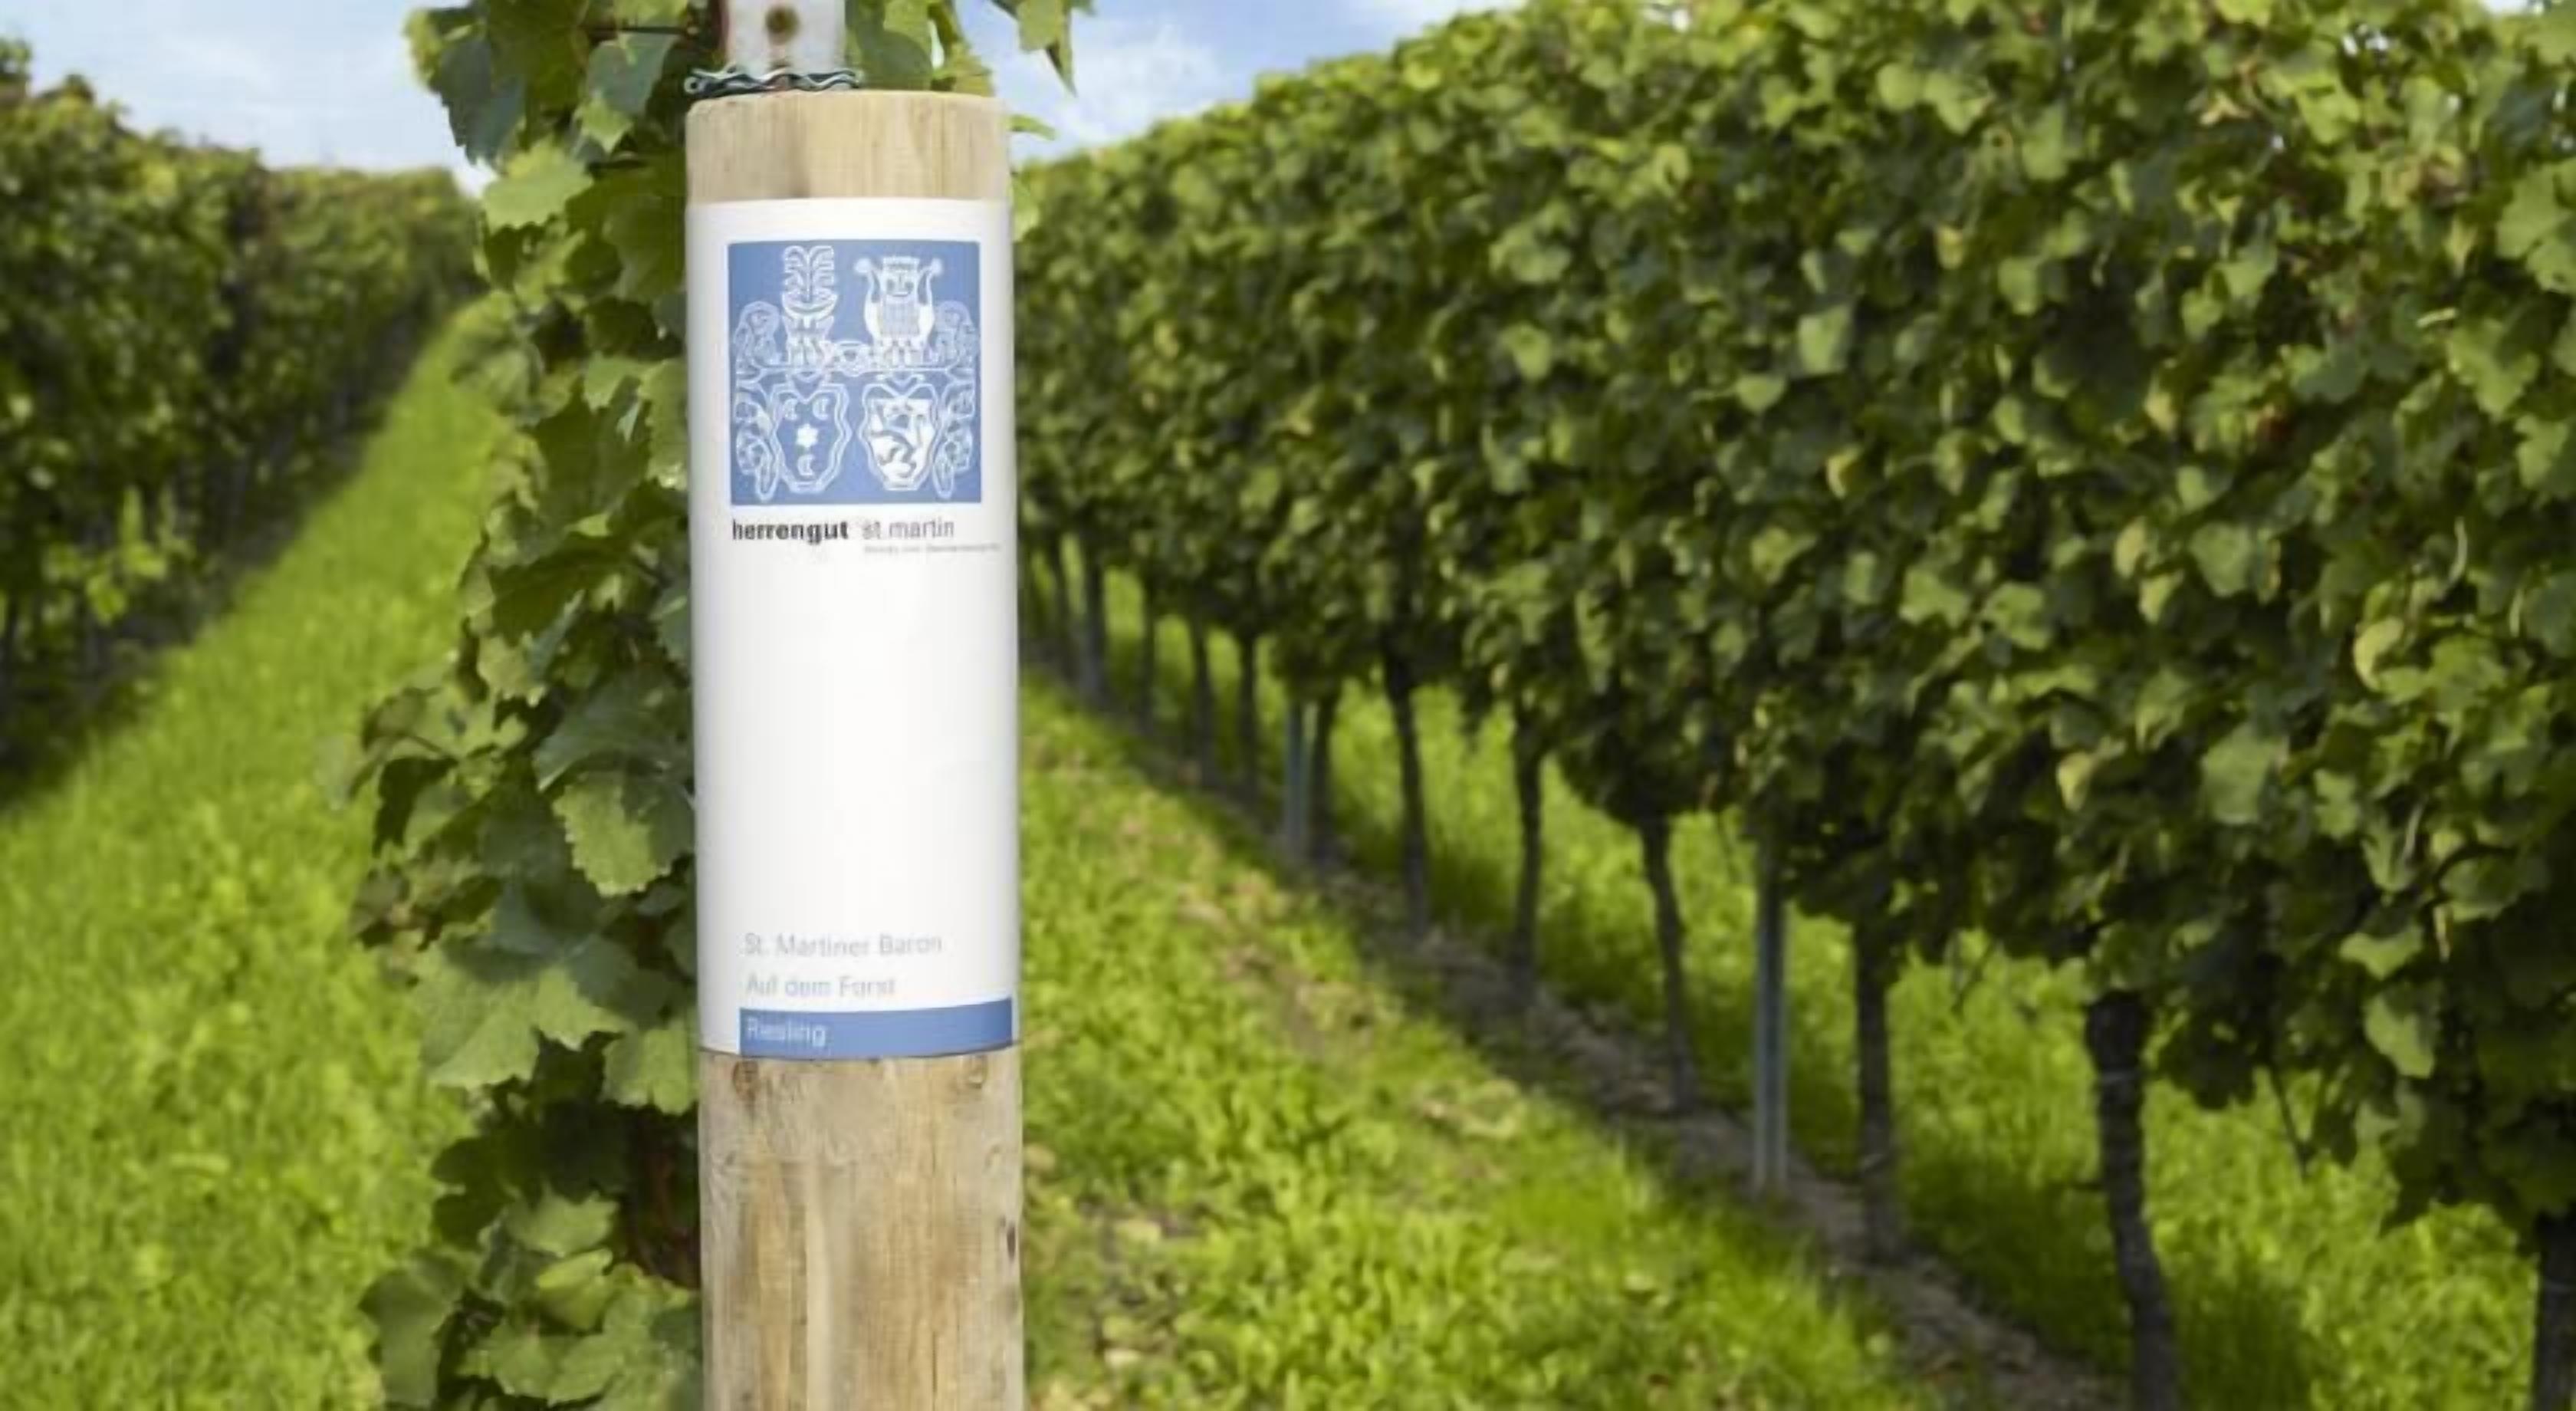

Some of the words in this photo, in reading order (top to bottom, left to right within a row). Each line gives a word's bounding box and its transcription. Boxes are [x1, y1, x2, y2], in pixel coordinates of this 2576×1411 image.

[732, 519, 849, 545] herrengut
[889, 516, 955, 538] martin
[879, 933, 942, 955] Baron
[747, 1015, 826, 1048] Riesling
